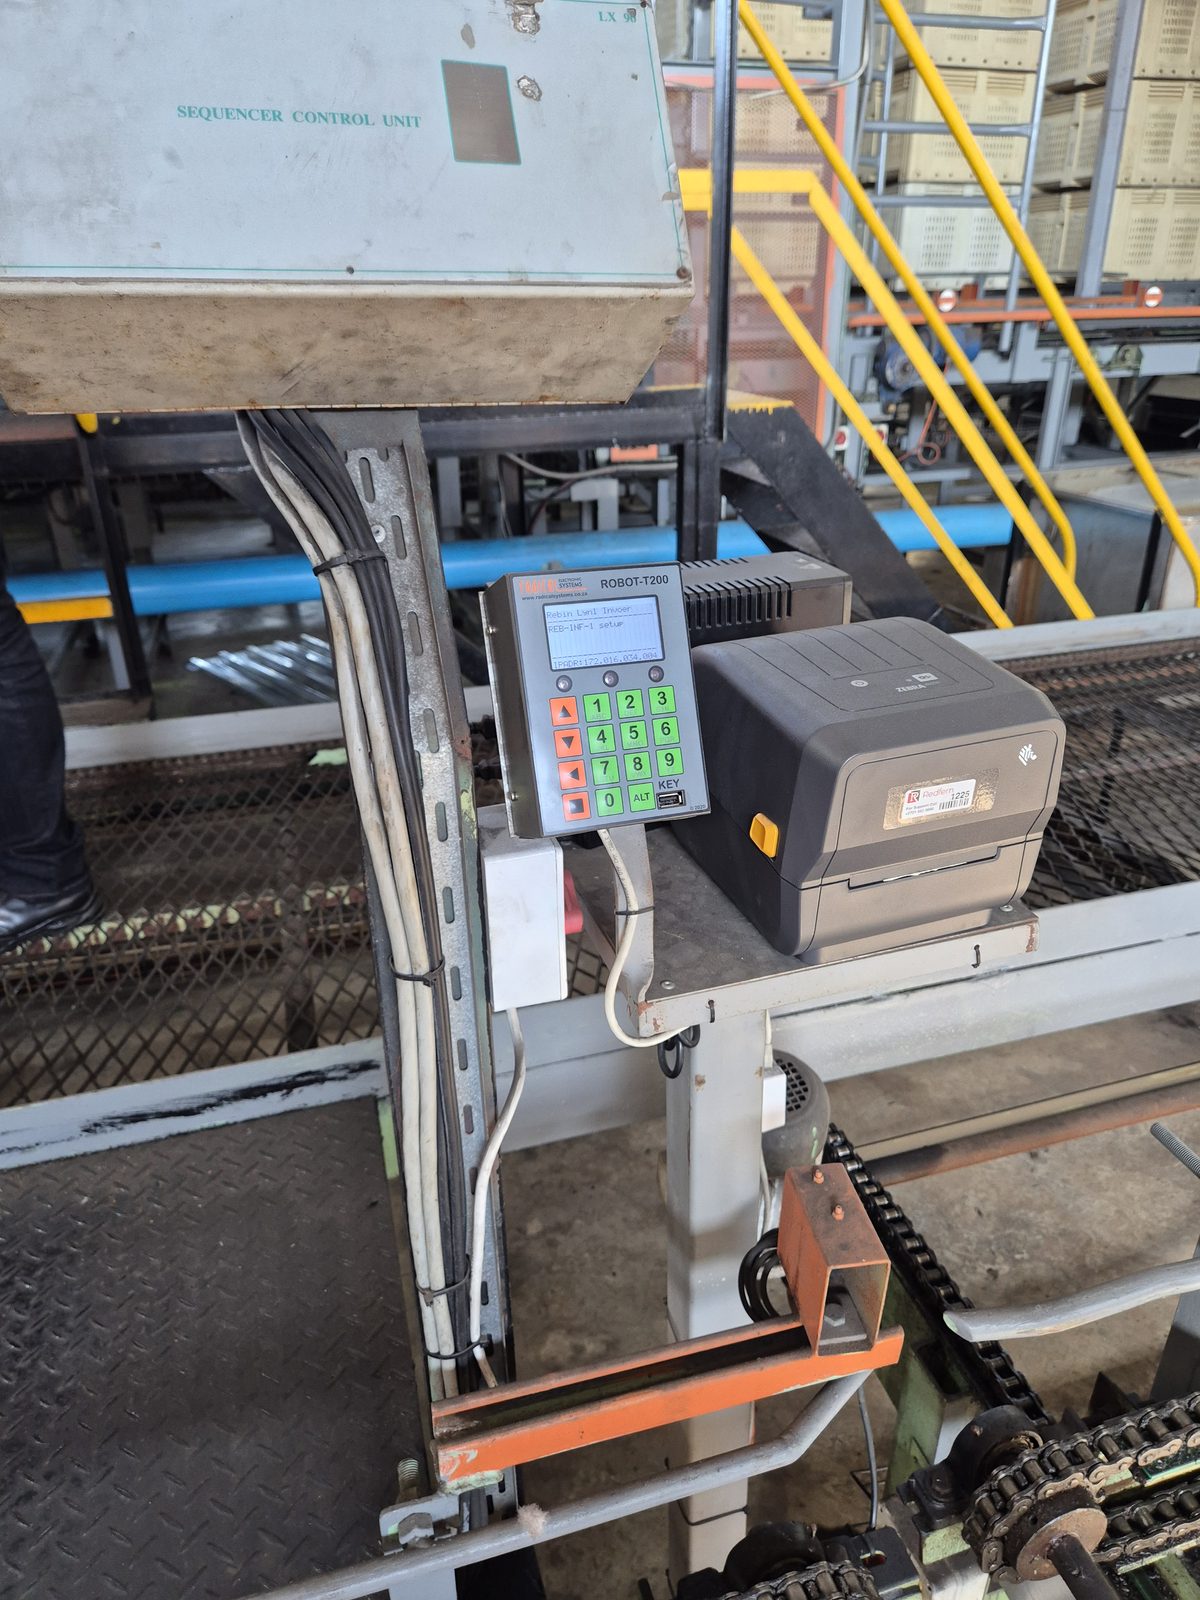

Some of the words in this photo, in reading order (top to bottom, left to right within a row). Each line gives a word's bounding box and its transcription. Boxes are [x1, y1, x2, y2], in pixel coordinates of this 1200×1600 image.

[598, 11, 617, 22] LX
[177, 105, 284, 123] SEQUENCER
[292, 110, 375, 126] CONTROL
[382, 114, 422, 128] UNIT
[600, 574, 669, 589] ROBOT-T200
[546, 610, 573, 619] Rebin
[603, 606, 631, 614] Invoer
[599, 621, 624, 631] setup
[895, 684, 927, 693] ZEBRA
[593, 698, 601, 713] 1
[624, 694, 635, 709] 2
[657, 691, 667, 706] 3
[629, 725, 639, 740] 5
[660, 721, 671, 736] 6
[596, 729, 607, 744] 4
[632, 756, 643, 771] 8
[664, 752, 675, 767] 9
[599, 760, 609, 775] 7
[658, 779, 680, 790] KEY
[605, 792, 615, 807] 0
[633, 792, 650, 802] ALT
[922, 787, 954, 799] Redfern
[951, 790, 970, 800] 1225
